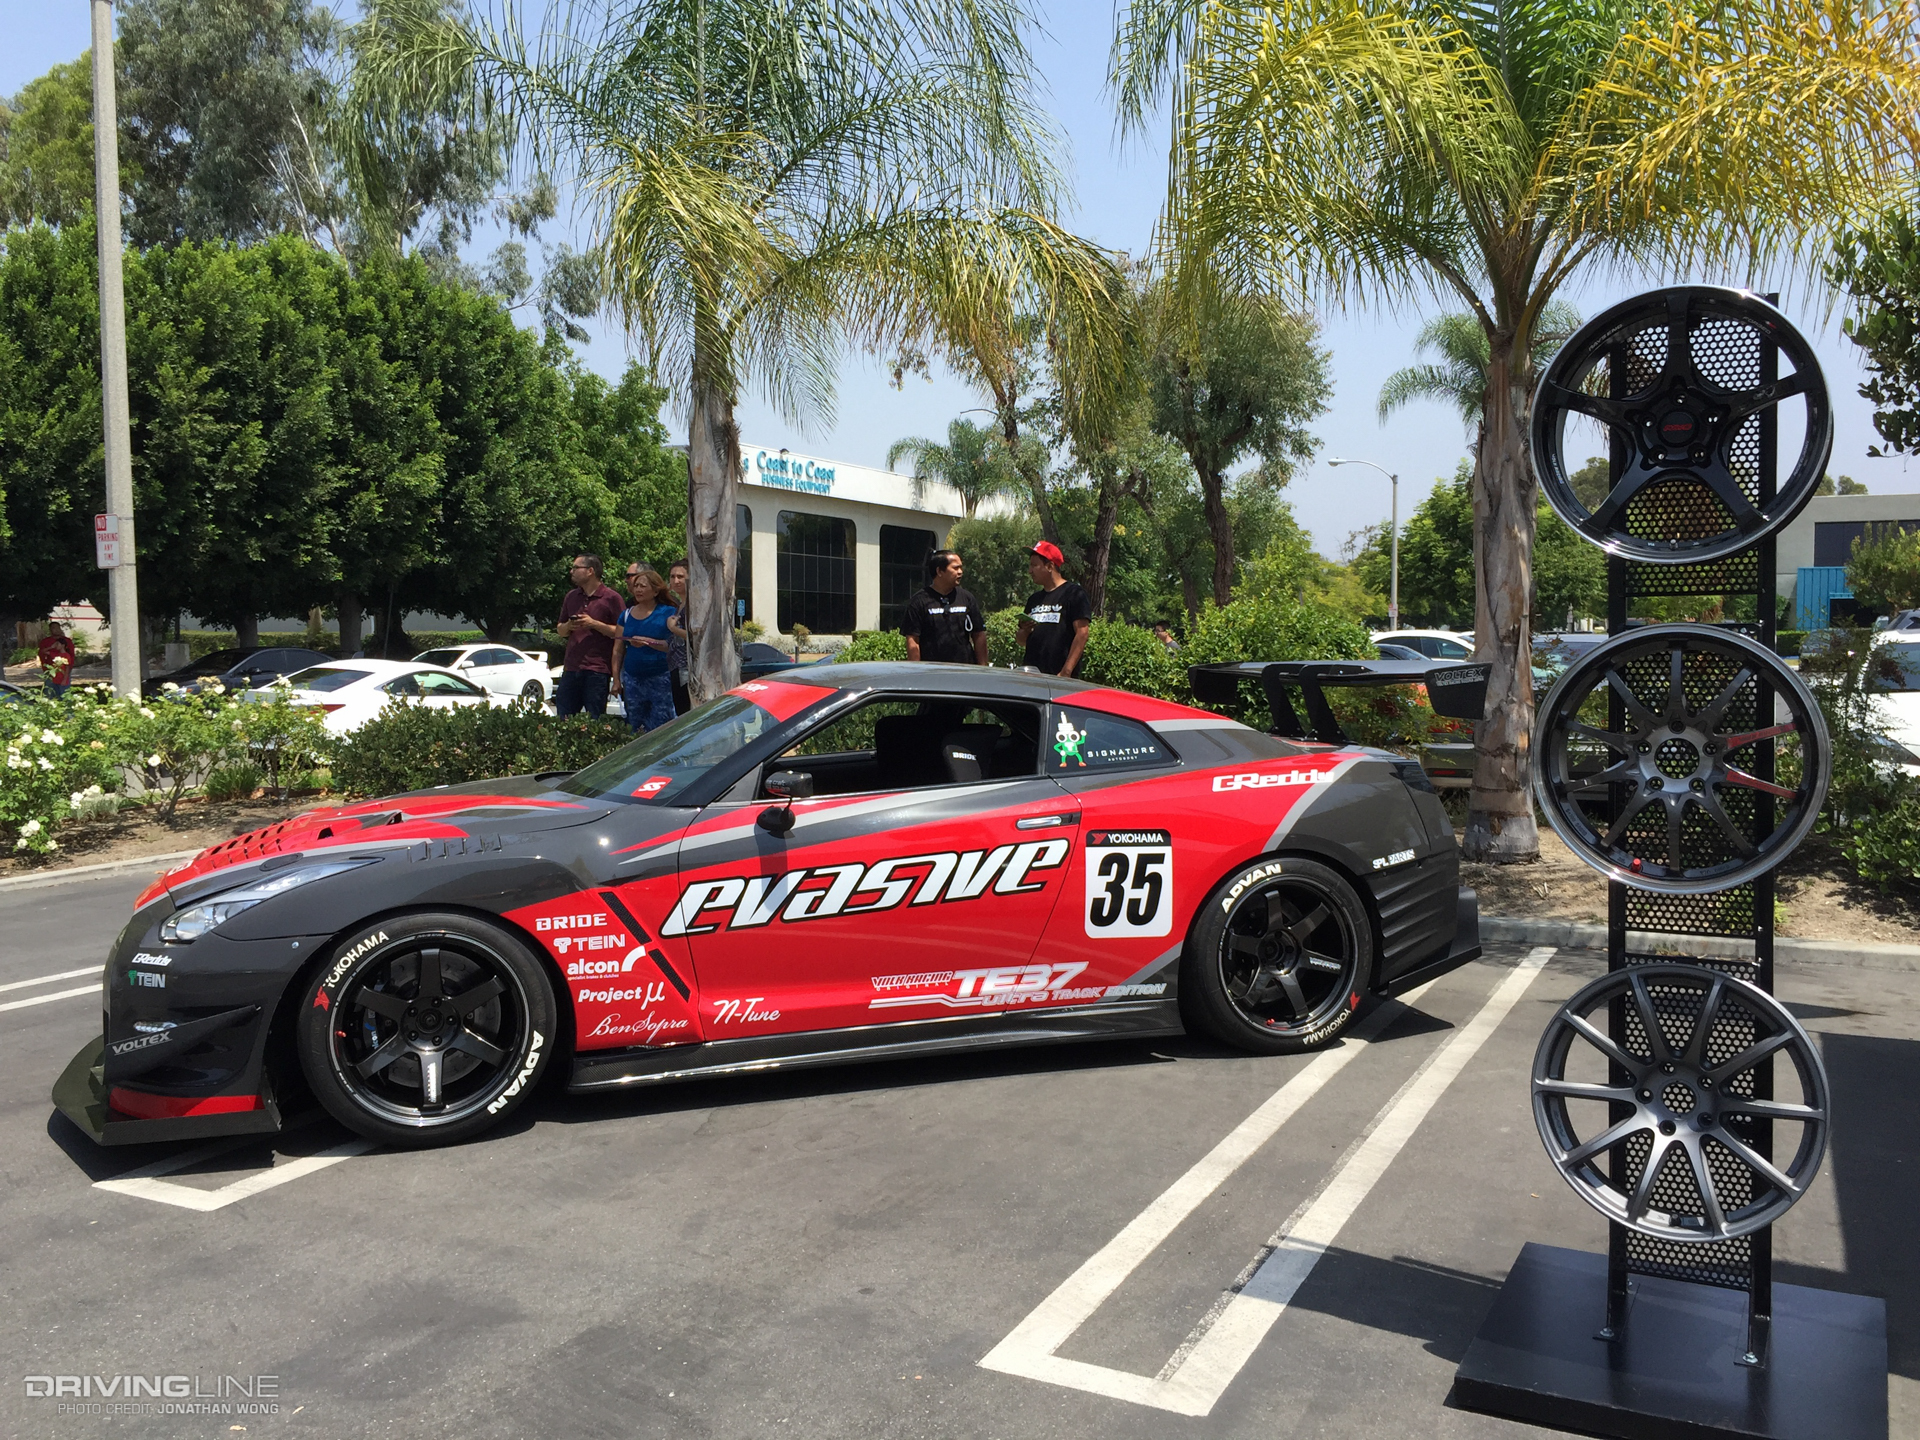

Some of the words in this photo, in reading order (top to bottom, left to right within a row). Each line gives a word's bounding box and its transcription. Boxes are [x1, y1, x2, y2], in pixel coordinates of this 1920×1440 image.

[756, 450, 789, 474] Coast
[791, 458, 803, 477] to
[805, 460, 836, 483] Coast
[761, 472, 794, 489] BUSINESS
[794, 478, 832, 496] EQUIPMENT
[97, 517, 106, 530] NO
[98, 532, 119, 542] PARKING
[104, 543, 113, 551] ANY
[1433, 666, 1485, 683] VOLTEX
[1087, 746, 1156, 758] SIGNATURE
[1107, 832, 1164, 844] YOKOHAMA
[659, 837, 1070, 938] evasive
[1089, 852, 1166, 928] 35
[1221, 863, 1282, 913] ADVAN
[535, 912, 608, 932] BRIDE
[572, 933, 625, 951] TEIN
[322, 930, 390, 989] YOKOHAMA
[567, 958, 620, 975] alcon
[137, 971, 166, 988] TEIN
[871, 974, 907, 989] VOLK
[904, 970, 954, 987] RACING
[952, 960, 1090, 998] TE37
[1051, 985, 1105, 1001] TRACK
[1103, 982, 1168, 997] EDITION
[713, 997, 780, 1024] N-Tune
[1302, 1008, 1352, 1045] YOKOHAMA
[111, 1031, 172, 1056] VOLTEX
[487, 1030, 544, 1115] ADVAN
